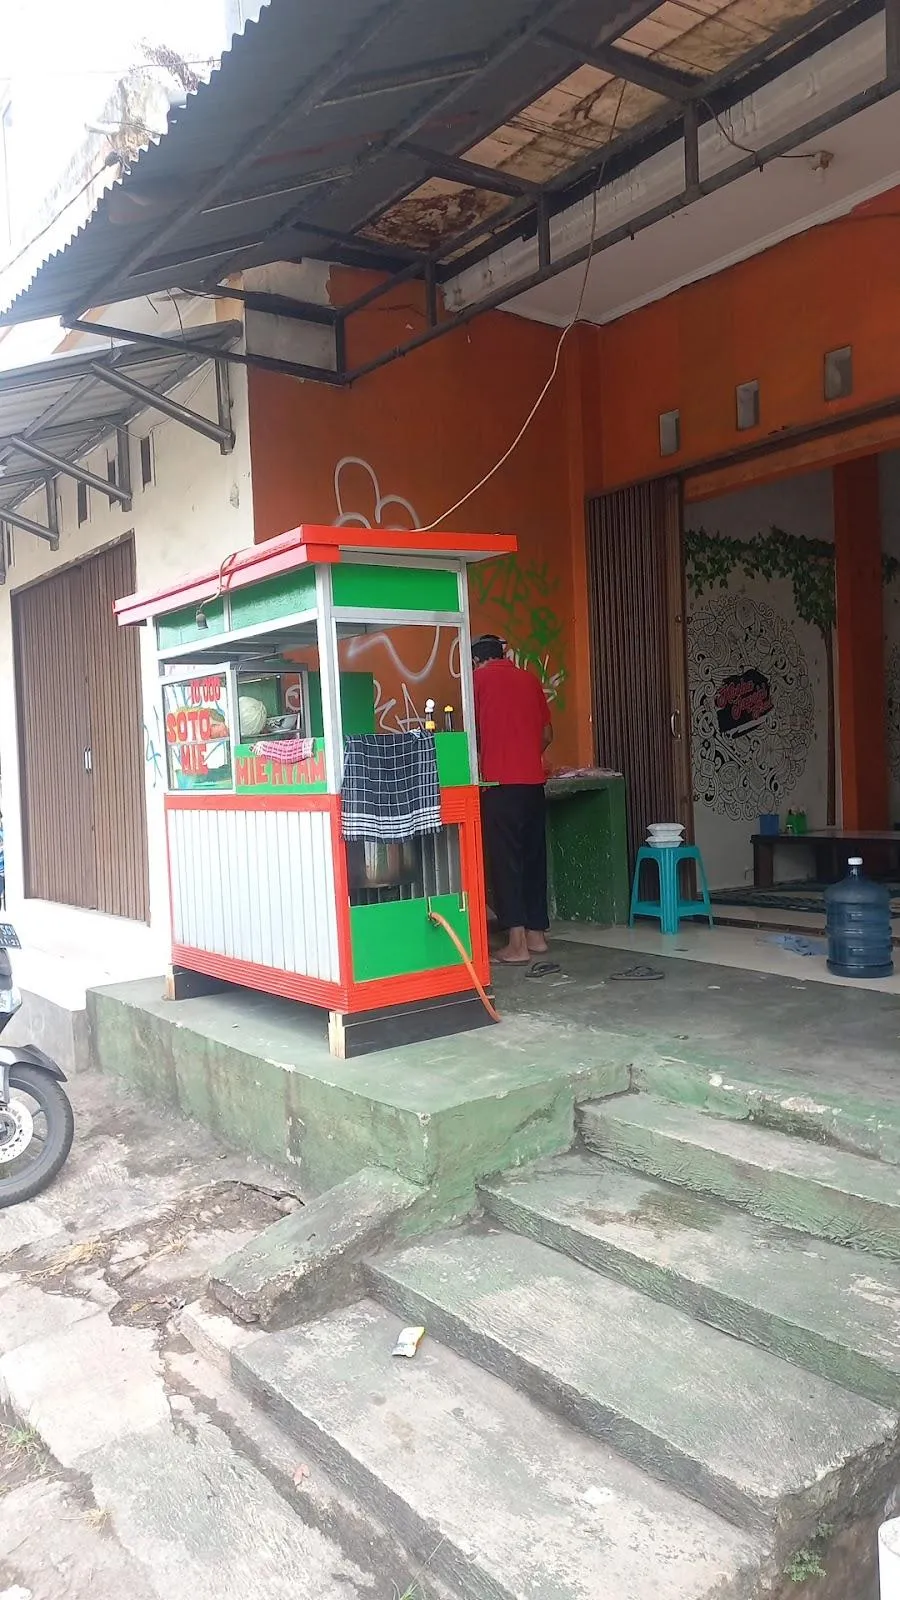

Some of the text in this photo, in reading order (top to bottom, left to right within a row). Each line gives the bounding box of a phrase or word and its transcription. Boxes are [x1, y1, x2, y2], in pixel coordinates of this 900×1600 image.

[166, 709, 211, 743] SOTO
[181, 743, 209, 775] MIE
[236, 751, 327, 785] MIE AYAM
